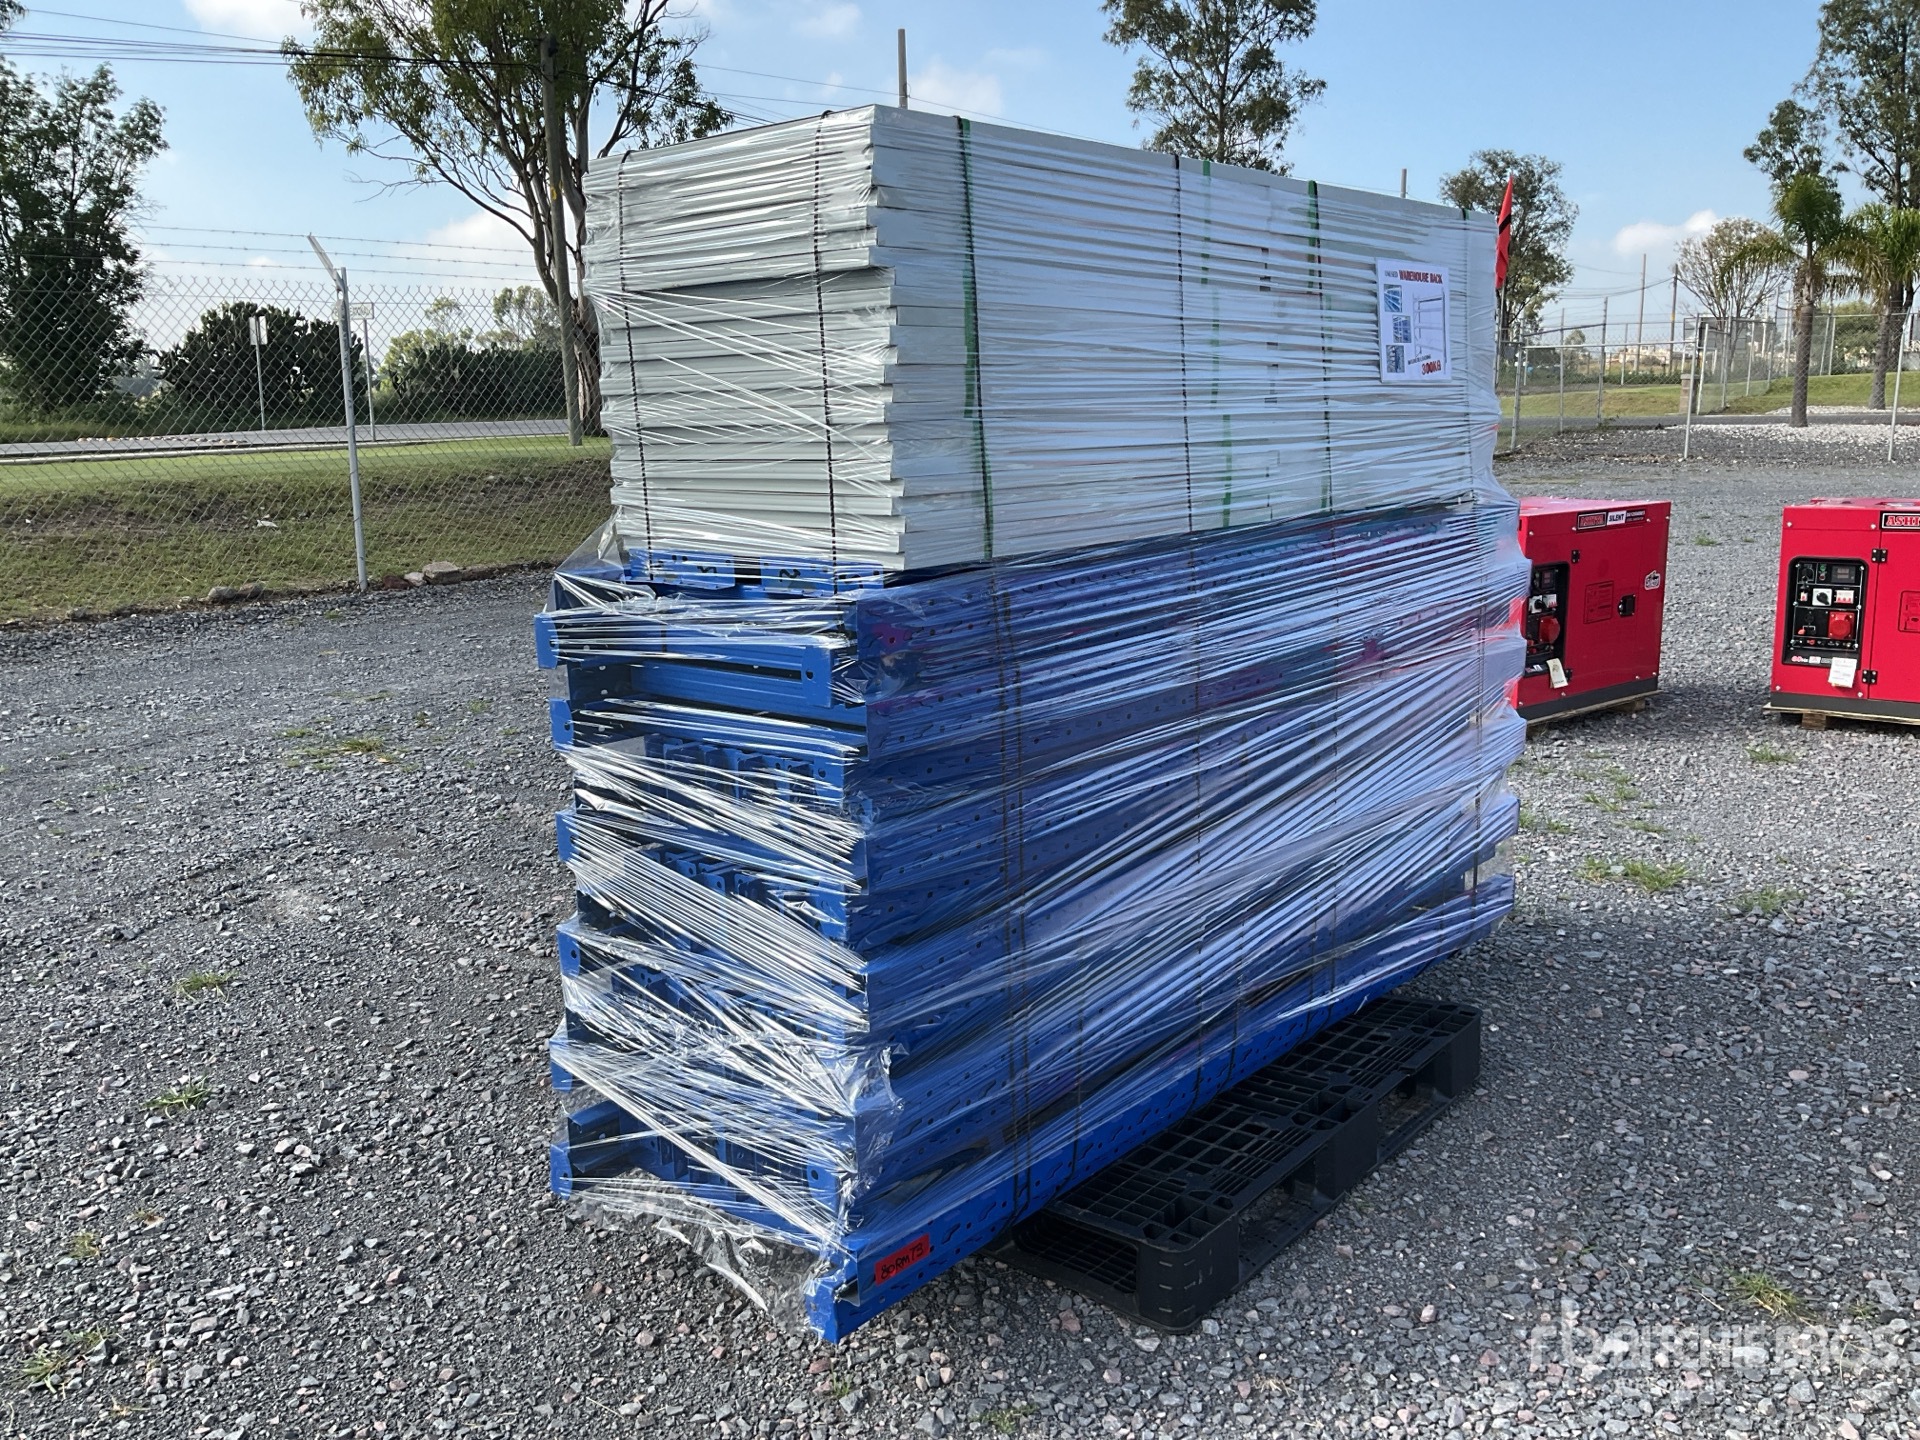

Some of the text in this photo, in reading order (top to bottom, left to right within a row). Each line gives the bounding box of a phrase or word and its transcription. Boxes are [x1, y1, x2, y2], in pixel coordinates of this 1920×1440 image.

[1398, 270, 1429, 283] WAREHOUSE
[1430, 273, 1442, 284] RACK
[1608, 514, 1624, 522] SILENT
